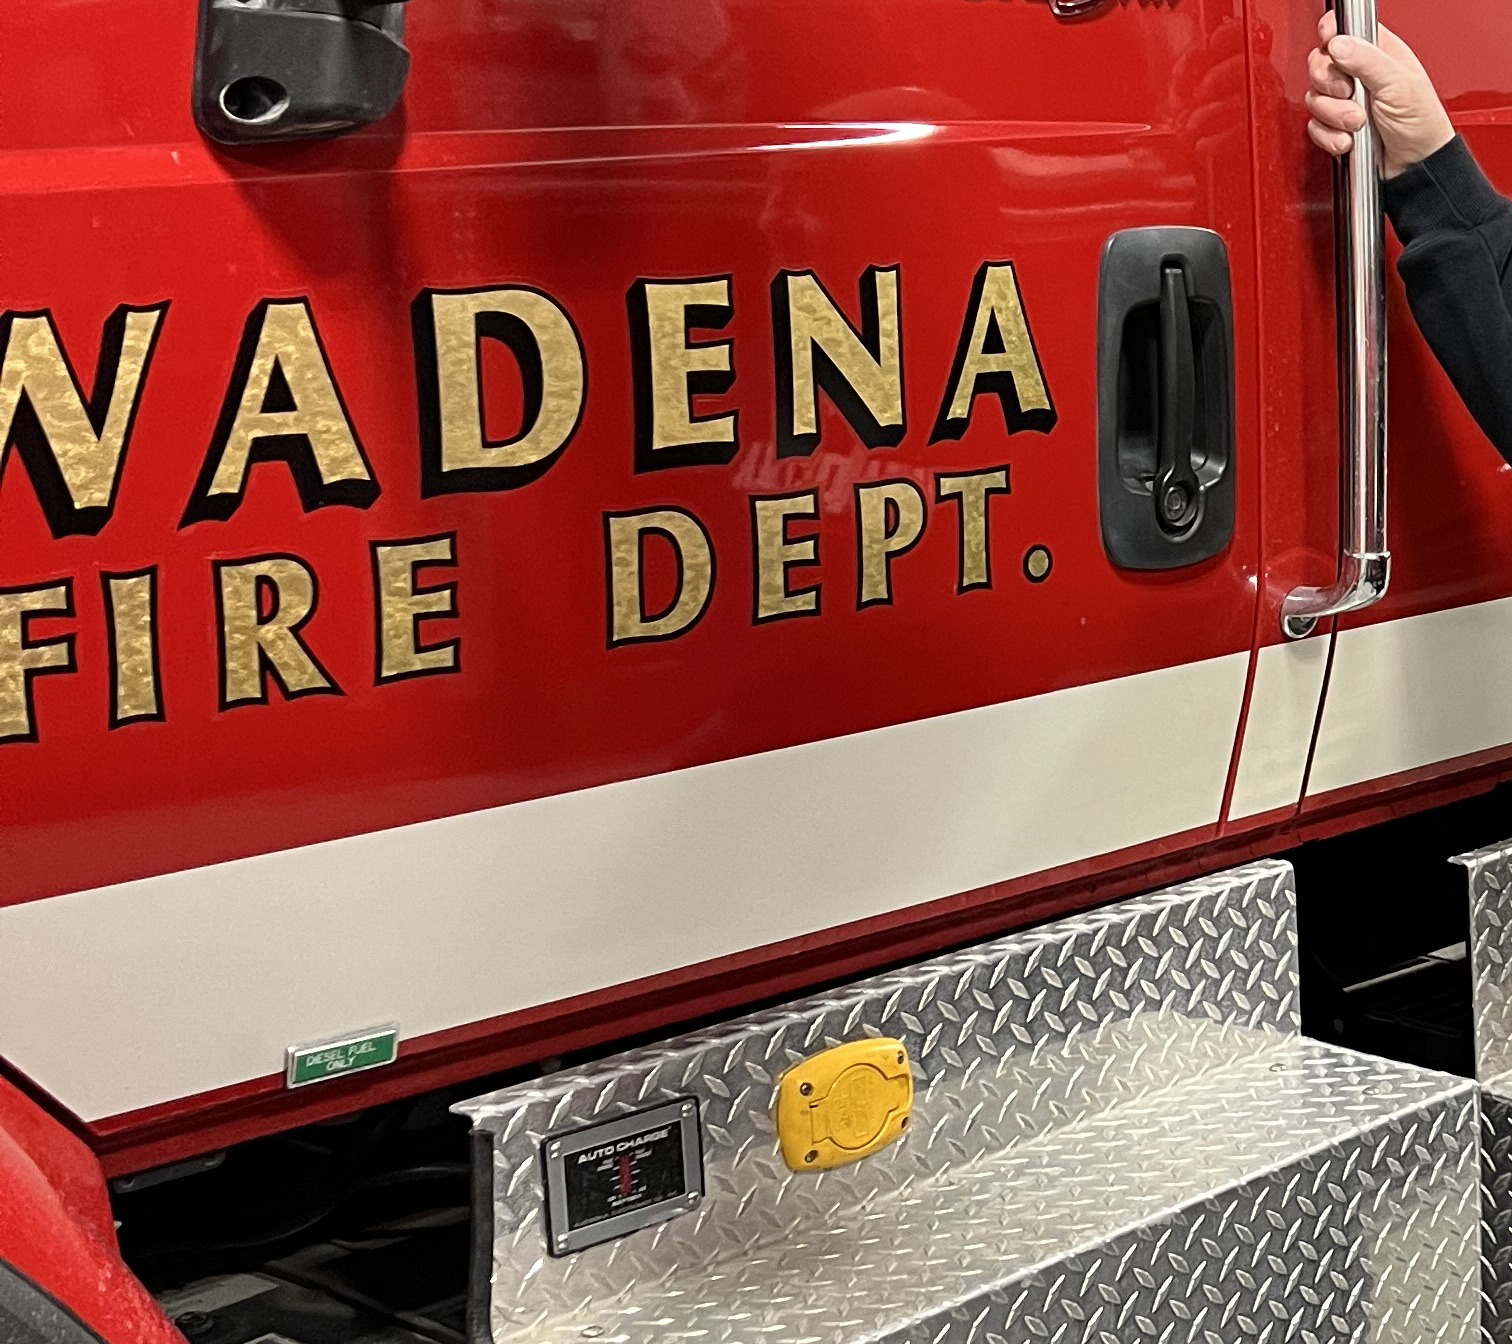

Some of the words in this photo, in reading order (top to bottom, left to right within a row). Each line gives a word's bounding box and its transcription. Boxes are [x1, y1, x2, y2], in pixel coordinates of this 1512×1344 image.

[0, 259, 1058, 540] WADENA
[0, 531, 461, 744] FIRE
[603, 464, 1053, 651] DEPT.
[305, 1048, 346, 1068] DIESEL
[347, 1040, 377, 1058] FUEL
[325, 1054, 358, 1072] ONLY
[577, 1144, 616, 1165] AUTO
[615, 1128, 671, 1153] CHARGE
